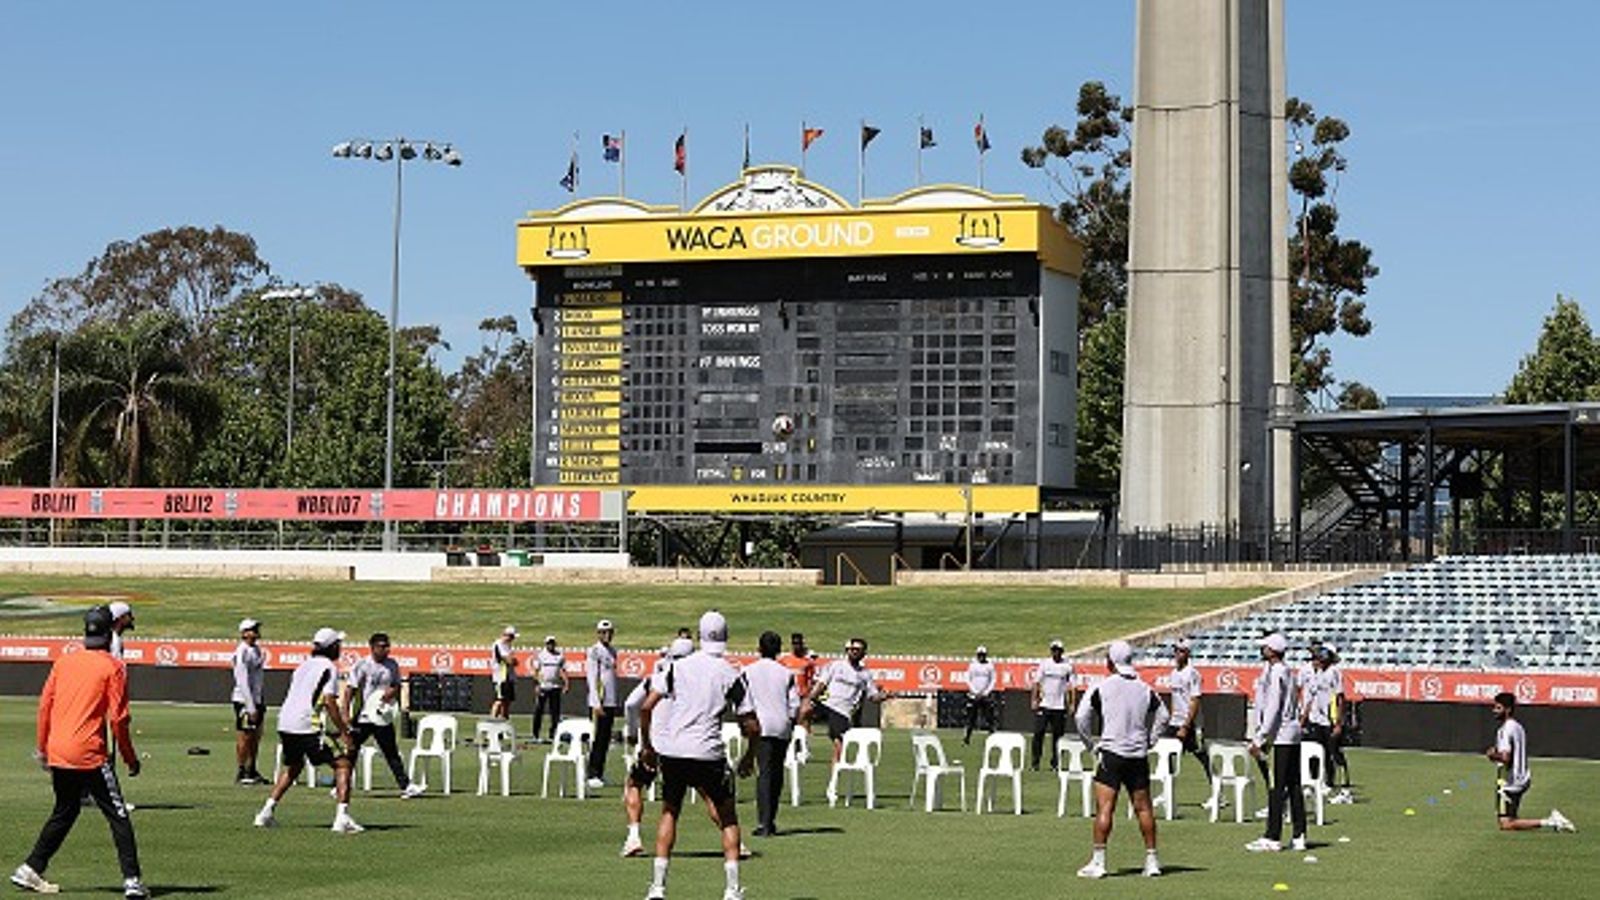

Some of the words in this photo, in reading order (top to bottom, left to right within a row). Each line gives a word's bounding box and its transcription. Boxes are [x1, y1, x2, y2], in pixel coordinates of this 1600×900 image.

[666, 226, 747, 251] WACA
[751, 221, 874, 248] GROUND
[436, 493, 581, 517] CHAMPIONS
[791, 492, 847, 503] COUNTRY
